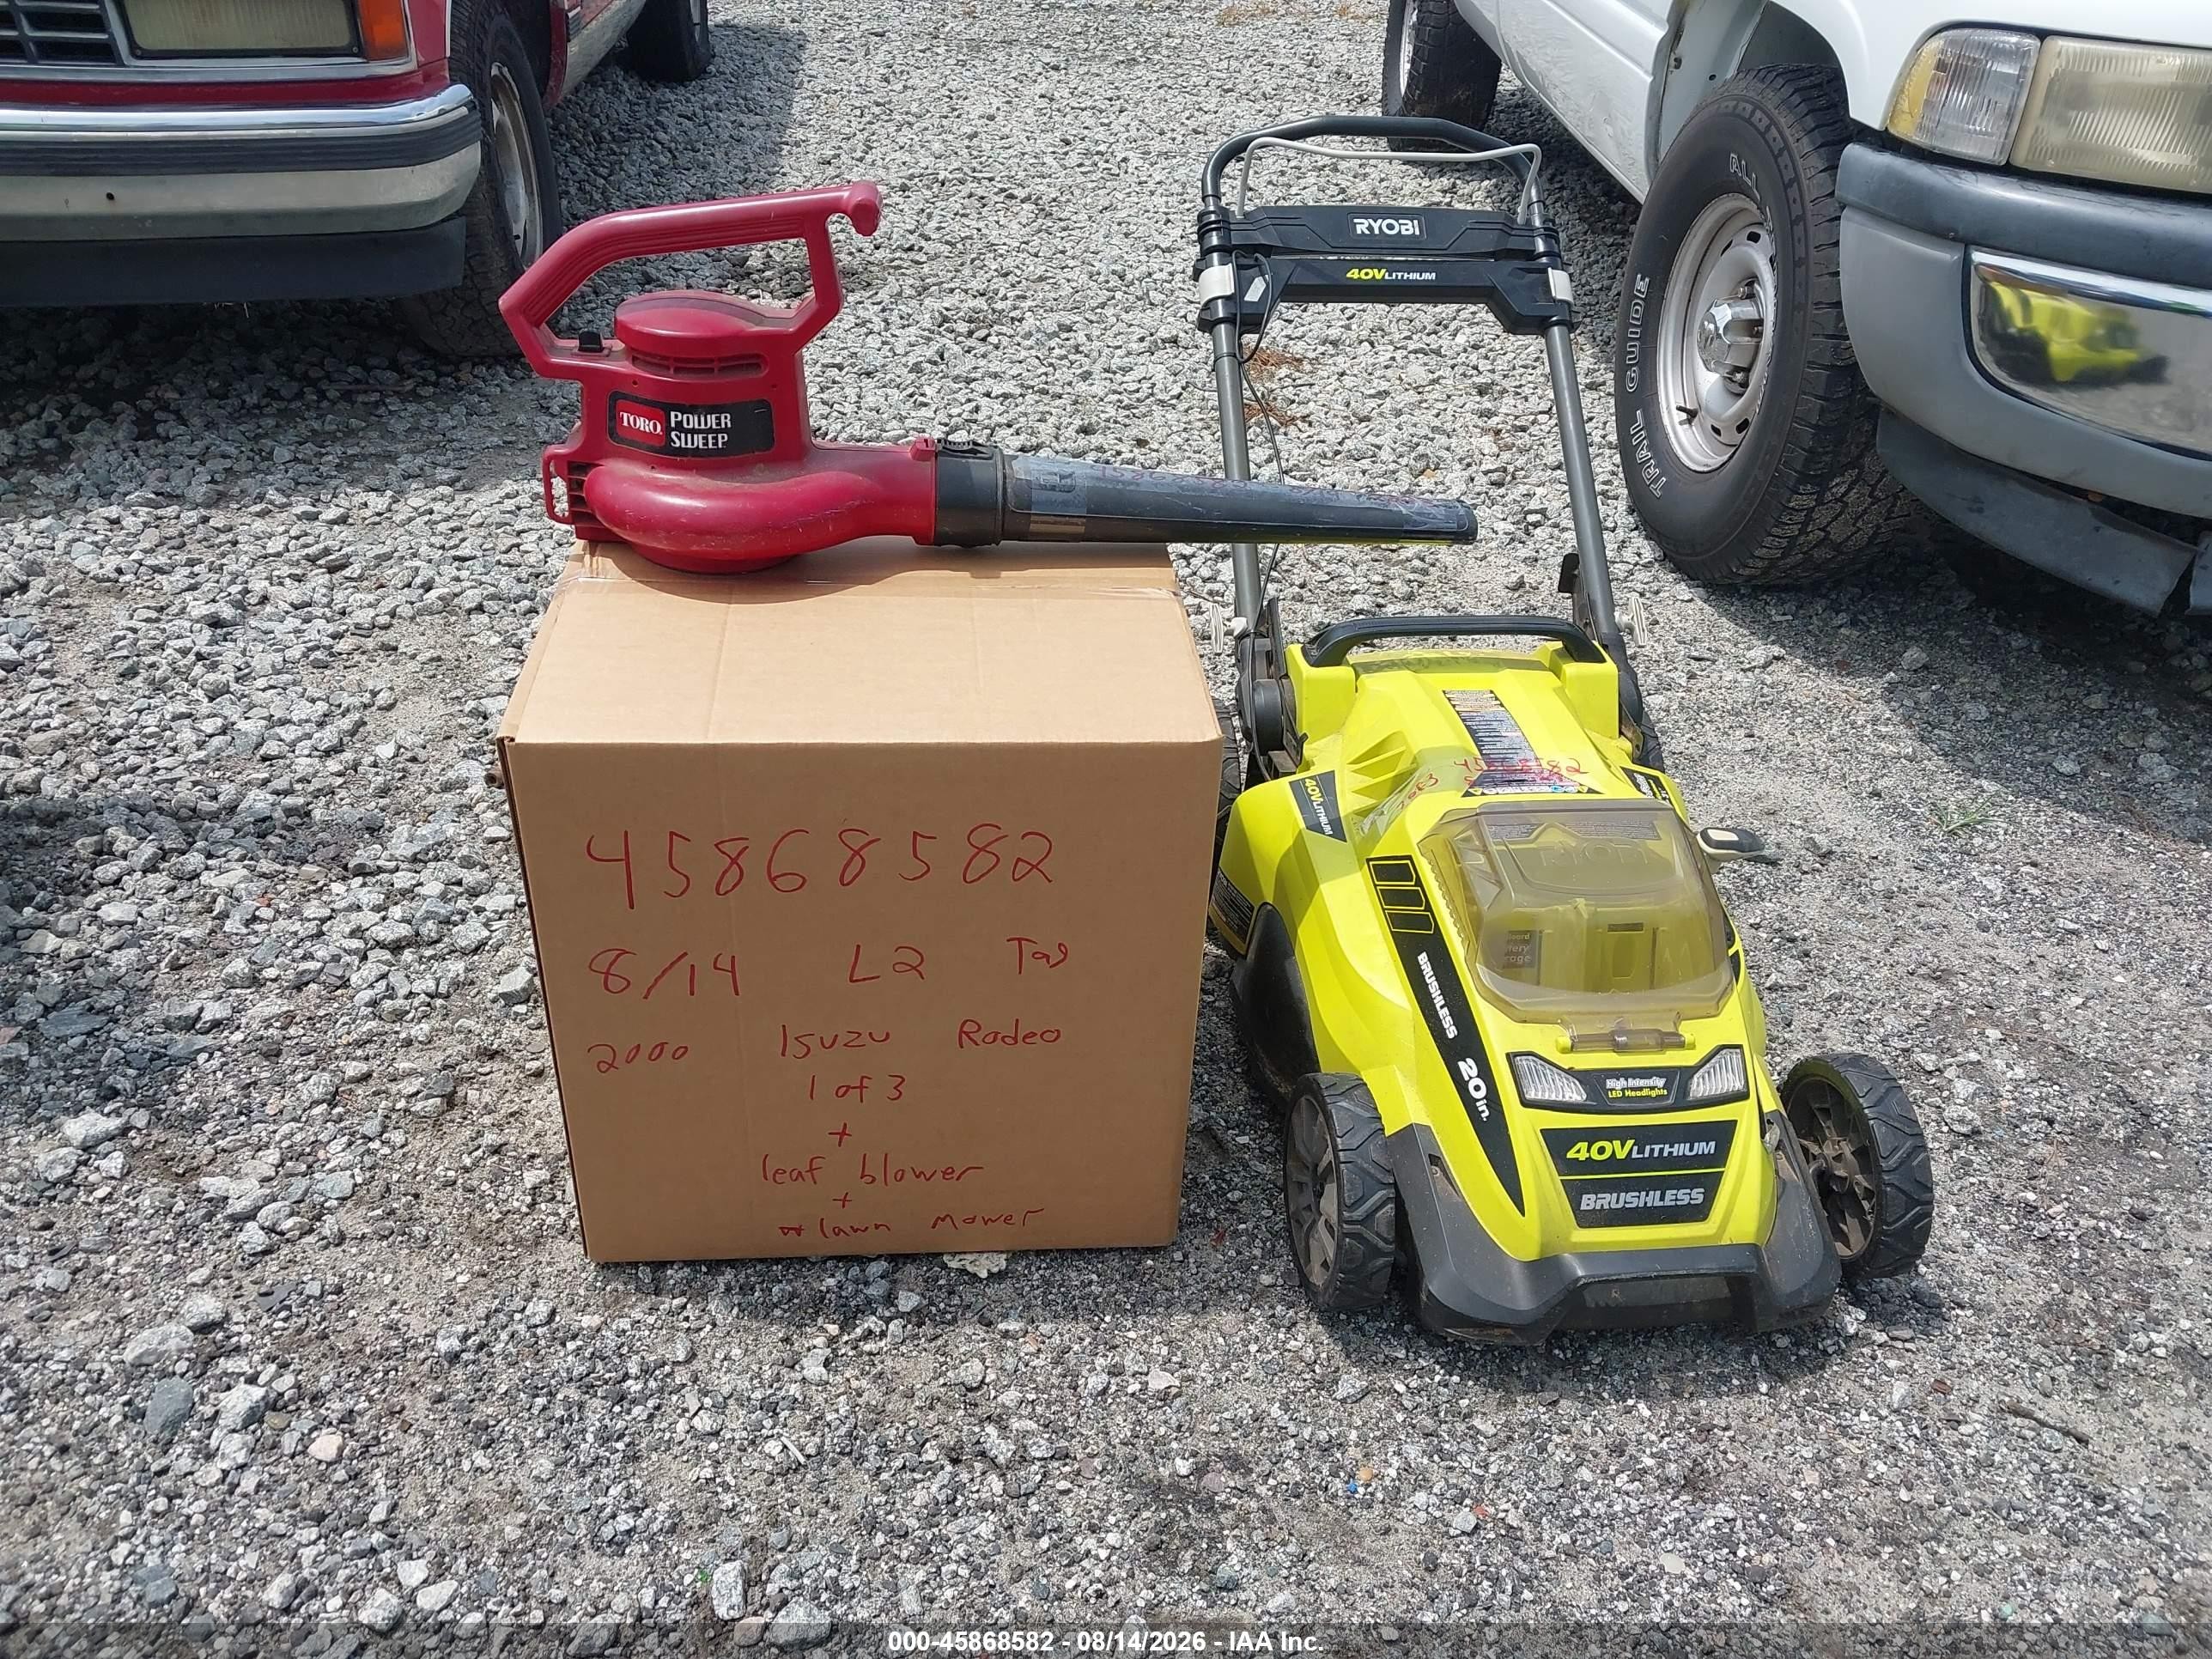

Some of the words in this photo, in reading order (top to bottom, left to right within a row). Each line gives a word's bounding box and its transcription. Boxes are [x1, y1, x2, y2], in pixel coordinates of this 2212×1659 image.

[1729, 153, 1760, 202] ALL
[1353, 218, 1419, 235] RYOBI
[1626, 273, 1650, 392] GUIDE
[671, 410, 732, 429] POWER
[671, 431, 728, 448] SWEEP
[1630, 410, 1666, 498] TRAIL
[1426, 773, 1439, 787] 3
[586, 823, 1053, 910] 45868582
[588, 948, 740, 1000] 8/14
[1418, 951, 1458, 1039] BRUSHLESS
[587, 1042, 689, 1073] 2000
[957, 1018, 1061, 1046] Rodeo
[835, 1075, 870, 1103] of
[887, 1075, 907, 1101] 3
[1606, 1078, 1627, 1090] High
[1628, 1076, 1667, 1088] Intensity
[1608, 1090, 1622, 1098] LED
[1625, 1088, 1668, 1097] Headlights
[762, 1153, 825, 1184] leaf
[860, 1152, 984, 1185] blower
[1580, 1188, 1705, 1211] BRUSHLESS
